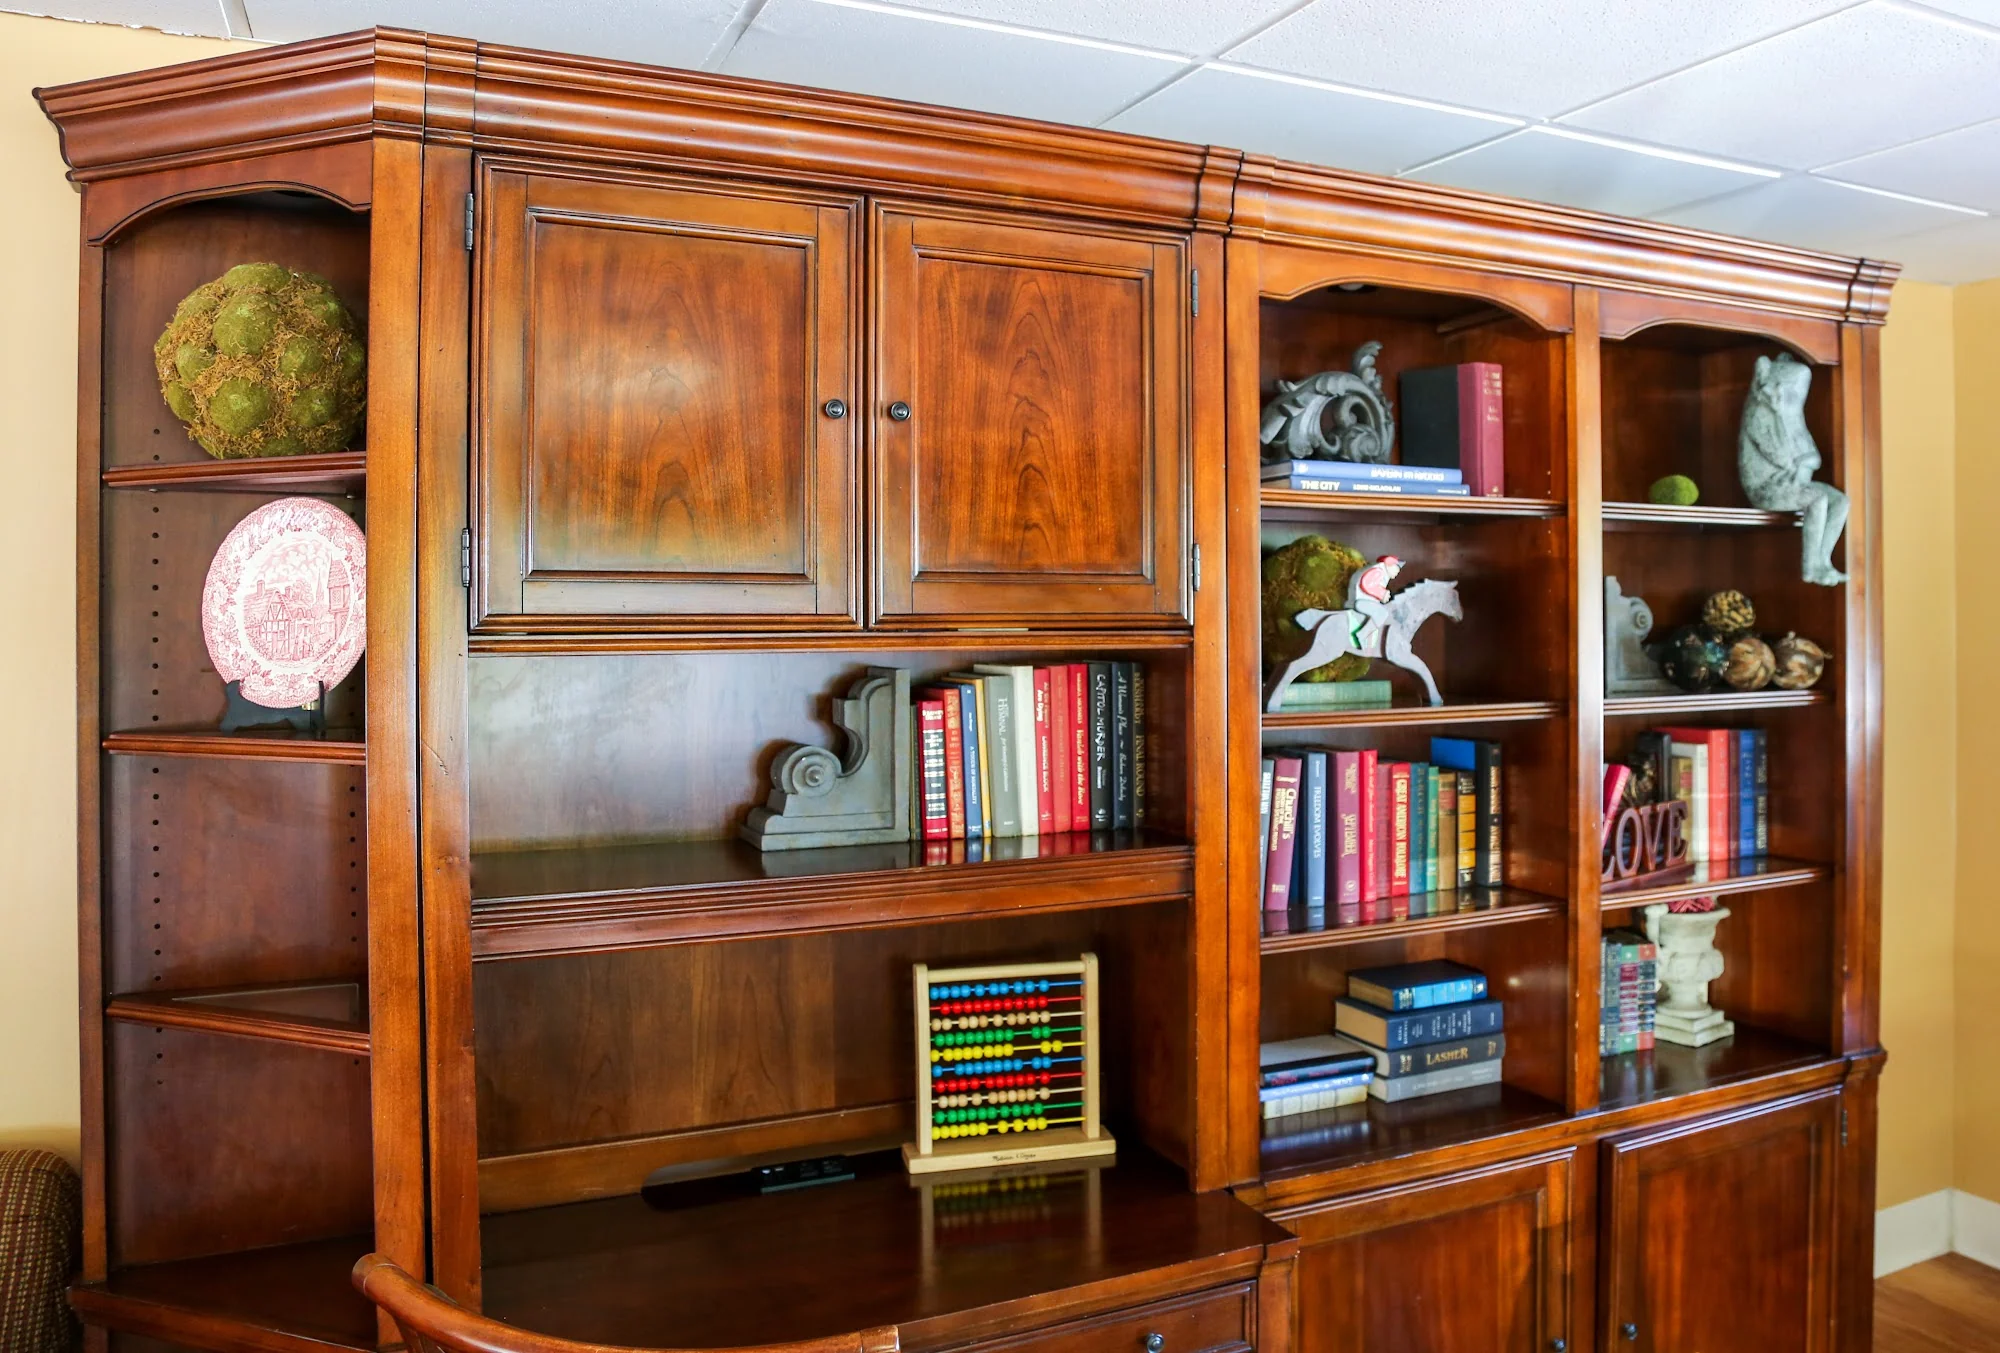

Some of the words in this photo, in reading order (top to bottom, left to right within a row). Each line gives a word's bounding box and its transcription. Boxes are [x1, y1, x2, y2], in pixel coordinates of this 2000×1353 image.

[1300, 481, 1320, 490] THE
[1320, 481, 1340, 491] CITY
[1036, 690, 1044, 702] Are
[1095, 673, 1107, 716] CAPITOL
[997, 698, 1008, 736] HYMNAL
[1036, 702, 1044, 723] Dying
[1117, 715, 1127, 736] Place
[1095, 717, 1107, 762] MURDER
[1136, 735, 1144, 761] FINAL
[1077, 756, 1085, 773] with
[1077, 773, 1085, 785] the
[1136, 762, 1145, 797] ROUND
[1077, 786, 1085, 806] Rose
[1313, 786, 1321, 823] FREEDOM
[1396, 779, 1407, 803] GREAT
[1282, 788, 1298, 840] Churchill's
[1395, 803, 1407, 840] AMERICAN
[1313, 825, 1321, 859] EVOLVES
[1341, 814, 1358, 857] SEPTEMBER
[1395, 842, 1407, 879] FOLKLORE
[1426, 1047, 1469, 1066] LASHER
